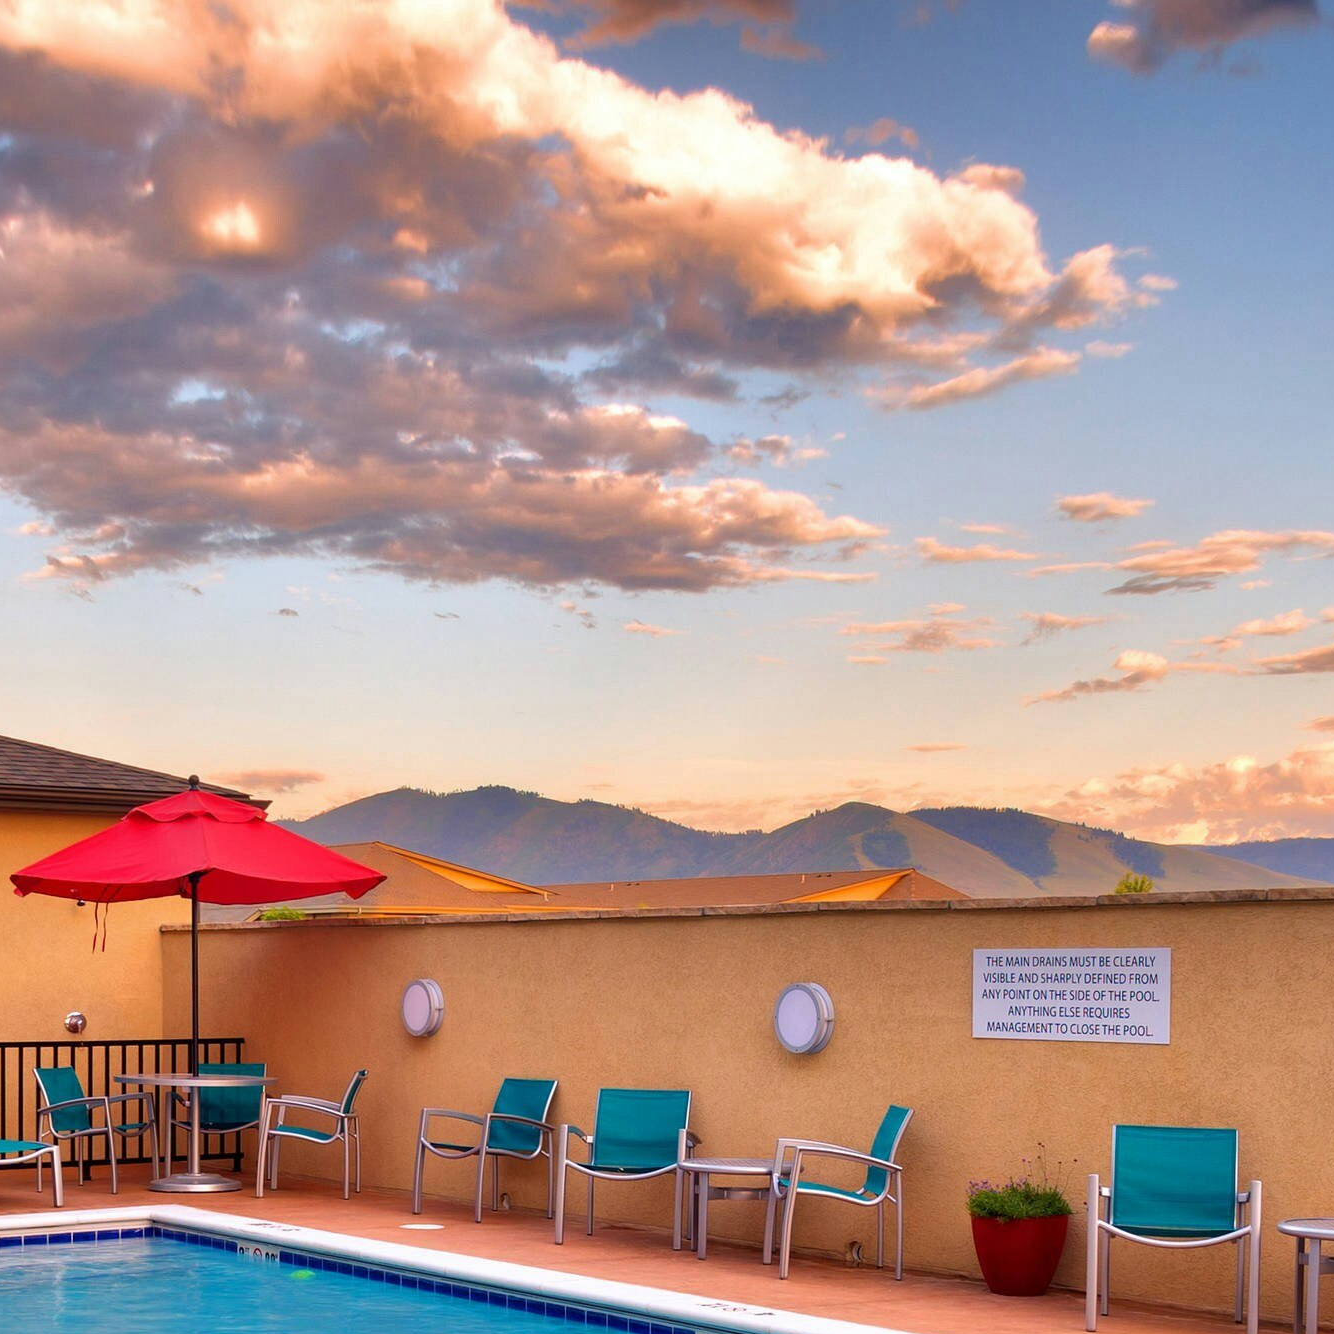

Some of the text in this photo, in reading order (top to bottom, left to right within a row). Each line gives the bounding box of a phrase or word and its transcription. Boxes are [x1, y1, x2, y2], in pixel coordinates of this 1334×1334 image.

[987, 956, 1156, 967] THE MAIN DRAINS MUST BE CLEARLY
[983, 973, 1158, 984] VISIBLE AND SHARPLY DEFINED FROM
[982, 989, 1160, 1002] ANY POINT ON THE SIDE OF THE POOL.
[1008, 1006, 1130, 1019] ANYTHING ELSE REQUIRES
[987, 1022, 1154, 1036] MANAGEMENT TO CLOSE THE POOL.
